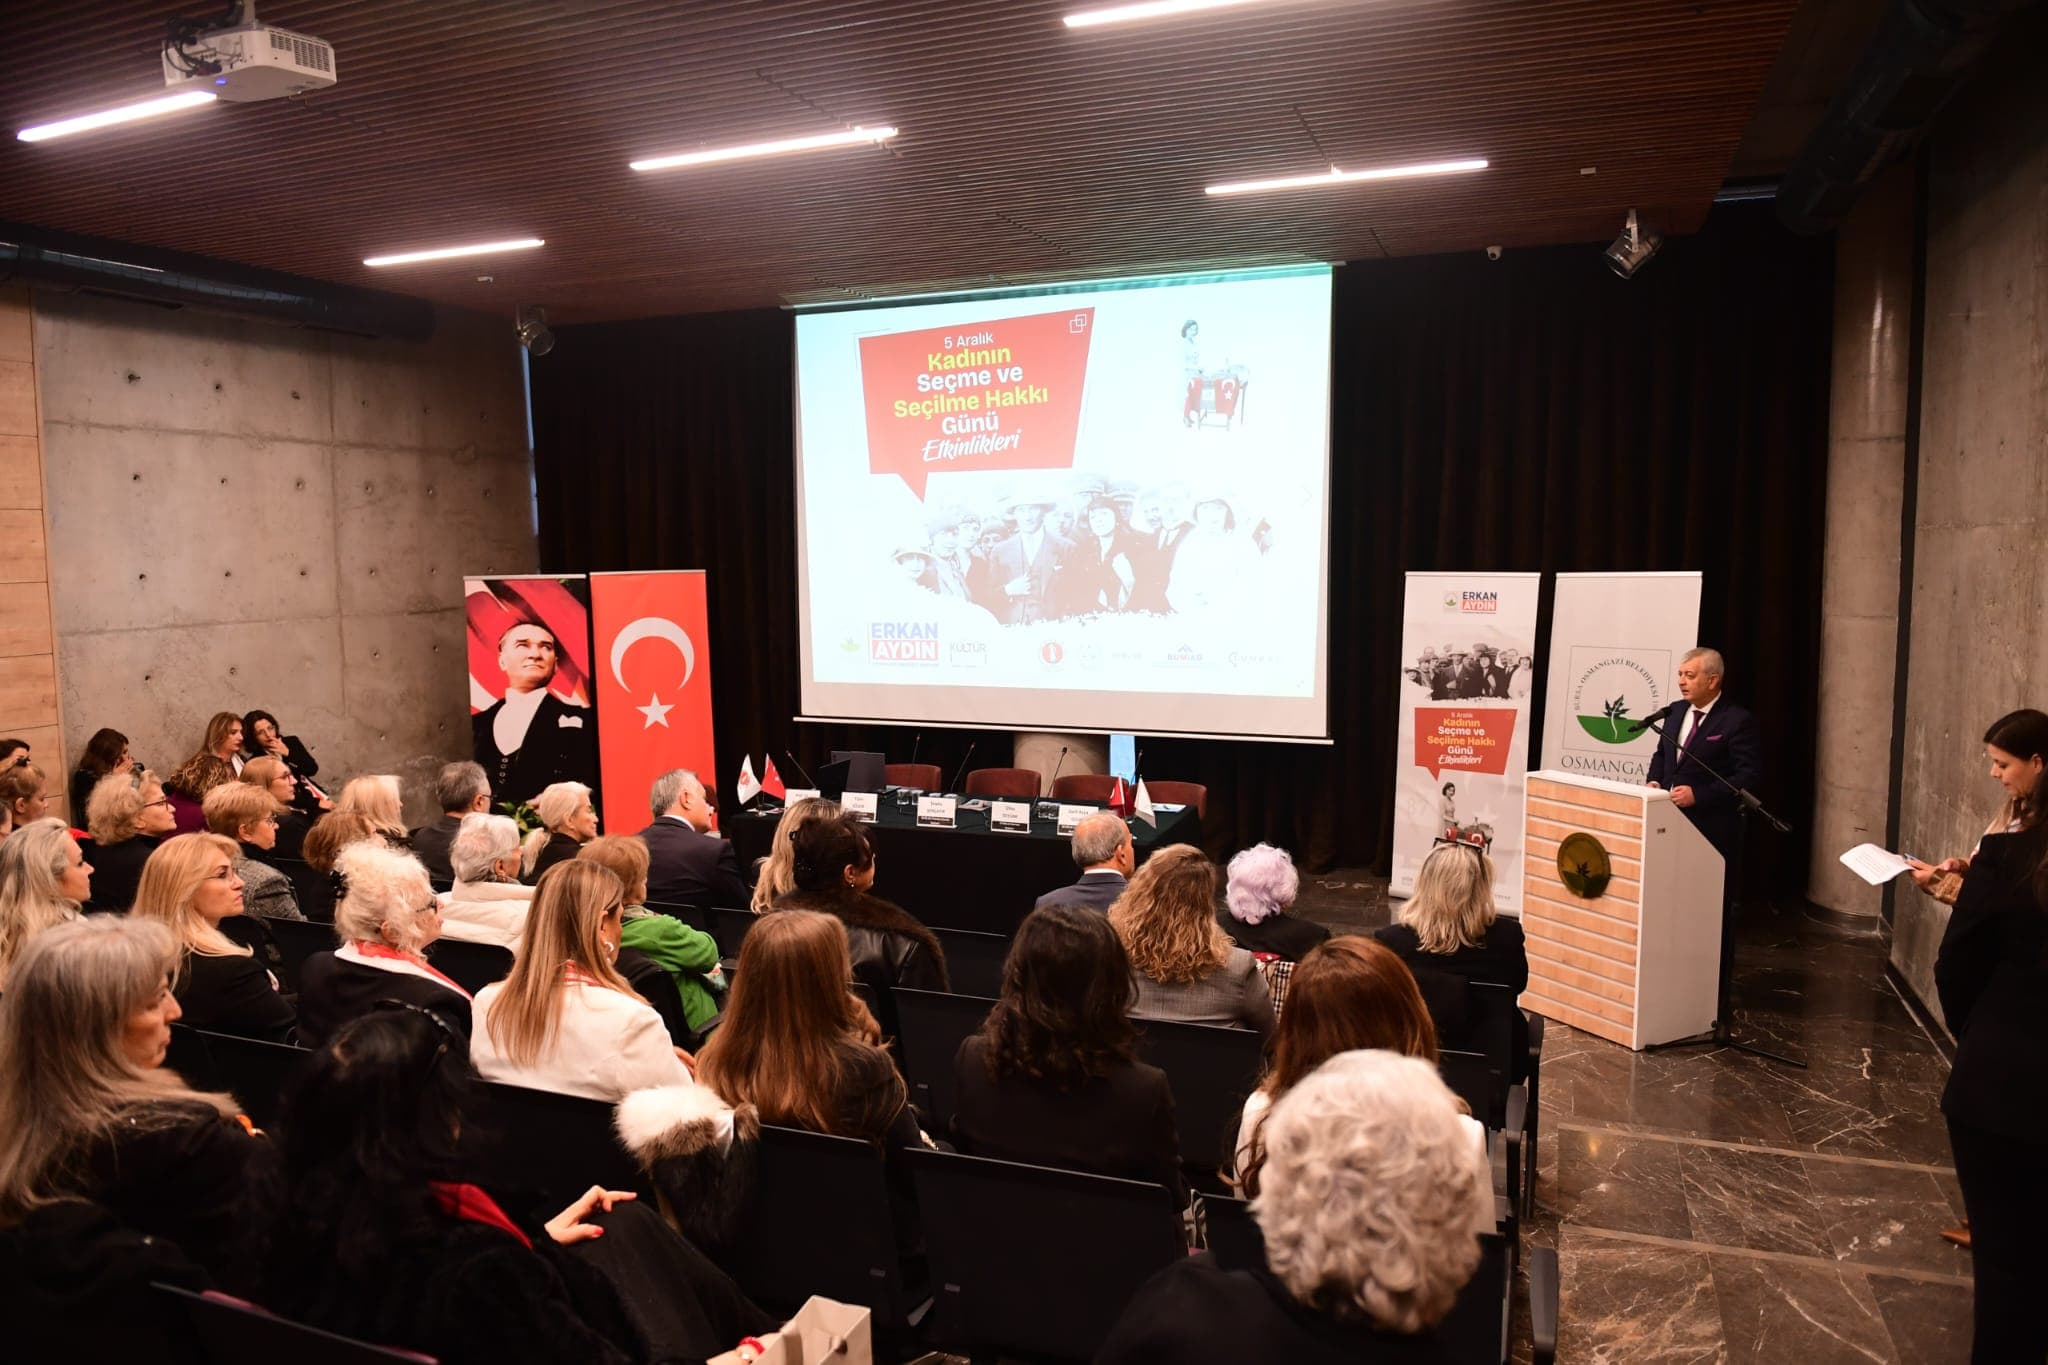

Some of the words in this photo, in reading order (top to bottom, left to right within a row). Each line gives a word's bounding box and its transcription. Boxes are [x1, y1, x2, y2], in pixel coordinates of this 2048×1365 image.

[944, 336, 953, 349] 5
[956, 332, 993, 347] Aralık
[927, 347, 1011, 372] Kadının
[917, 369, 991, 394] Seçme
[996, 365, 1023, 384] ve
[894, 392, 980, 420] Seçilme
[985, 385, 1048, 409] Hakkı
[941, 411, 998, 435] Günü
[920, 429, 1022, 462] Etkinlikleri
[1462, 591, 1497, 600] ERKAN
[1463, 601, 1496, 611] AYDIN
[871, 622, 939, 639] ERKAN
[874, 641, 937, 660] AYDIN
[1437, 725, 1471, 737] Seçme
[1473, 728, 1485, 736] ve
[1443, 718, 1480, 727] Kadının
[1426, 735, 1465, 747] Seçilme
[1467, 736, 1496, 747] Hakkı
[1447, 745, 1474, 755] Günü
[1561, 755, 1649, 776] OSMANGA
